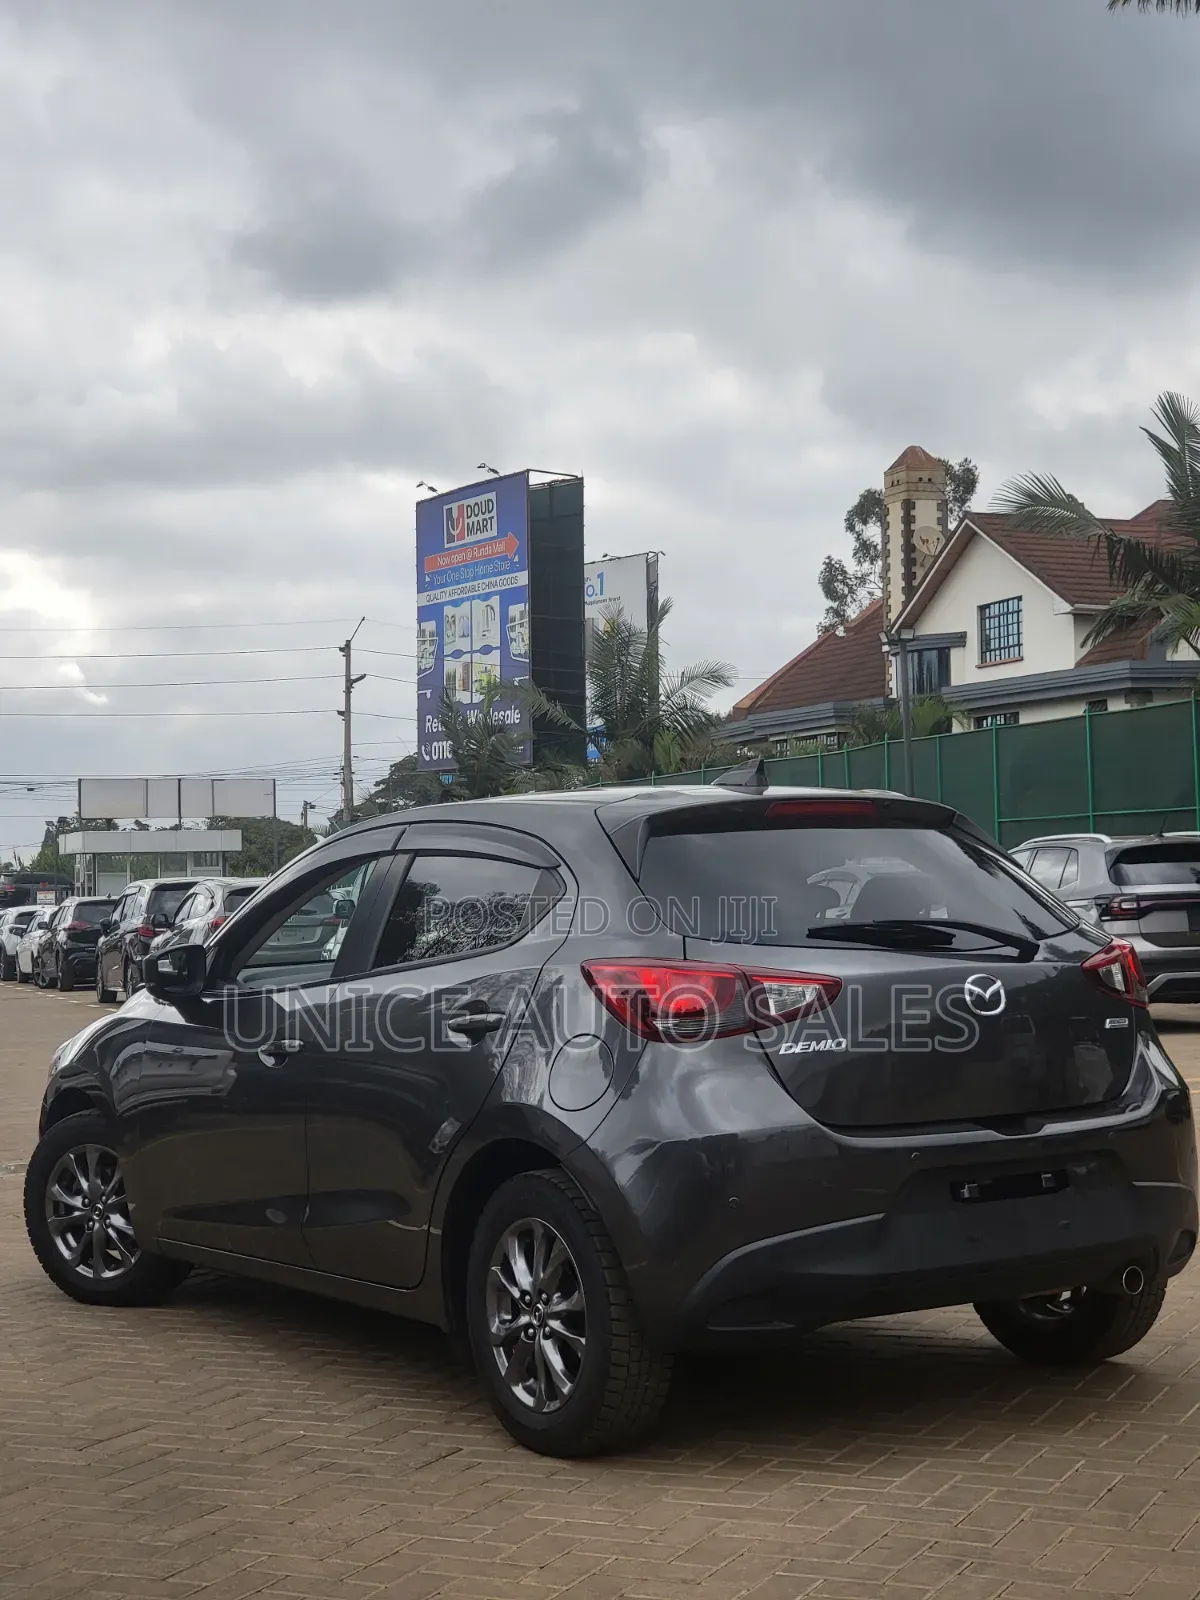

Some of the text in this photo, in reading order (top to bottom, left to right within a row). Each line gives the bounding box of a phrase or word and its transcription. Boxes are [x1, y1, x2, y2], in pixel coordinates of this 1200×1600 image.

[466, 498, 494, 520] DOUD
[466, 515, 494, 537] MART
[437, 541, 506, 567] Now open @ Runda Mall
[433, 559, 511, 585] Your One Stop Home Store
[425, 575, 519, 603] QUALITY AFFORDABLE CHINA GOODS
[778, 1037, 847, 1055] DEMIO
